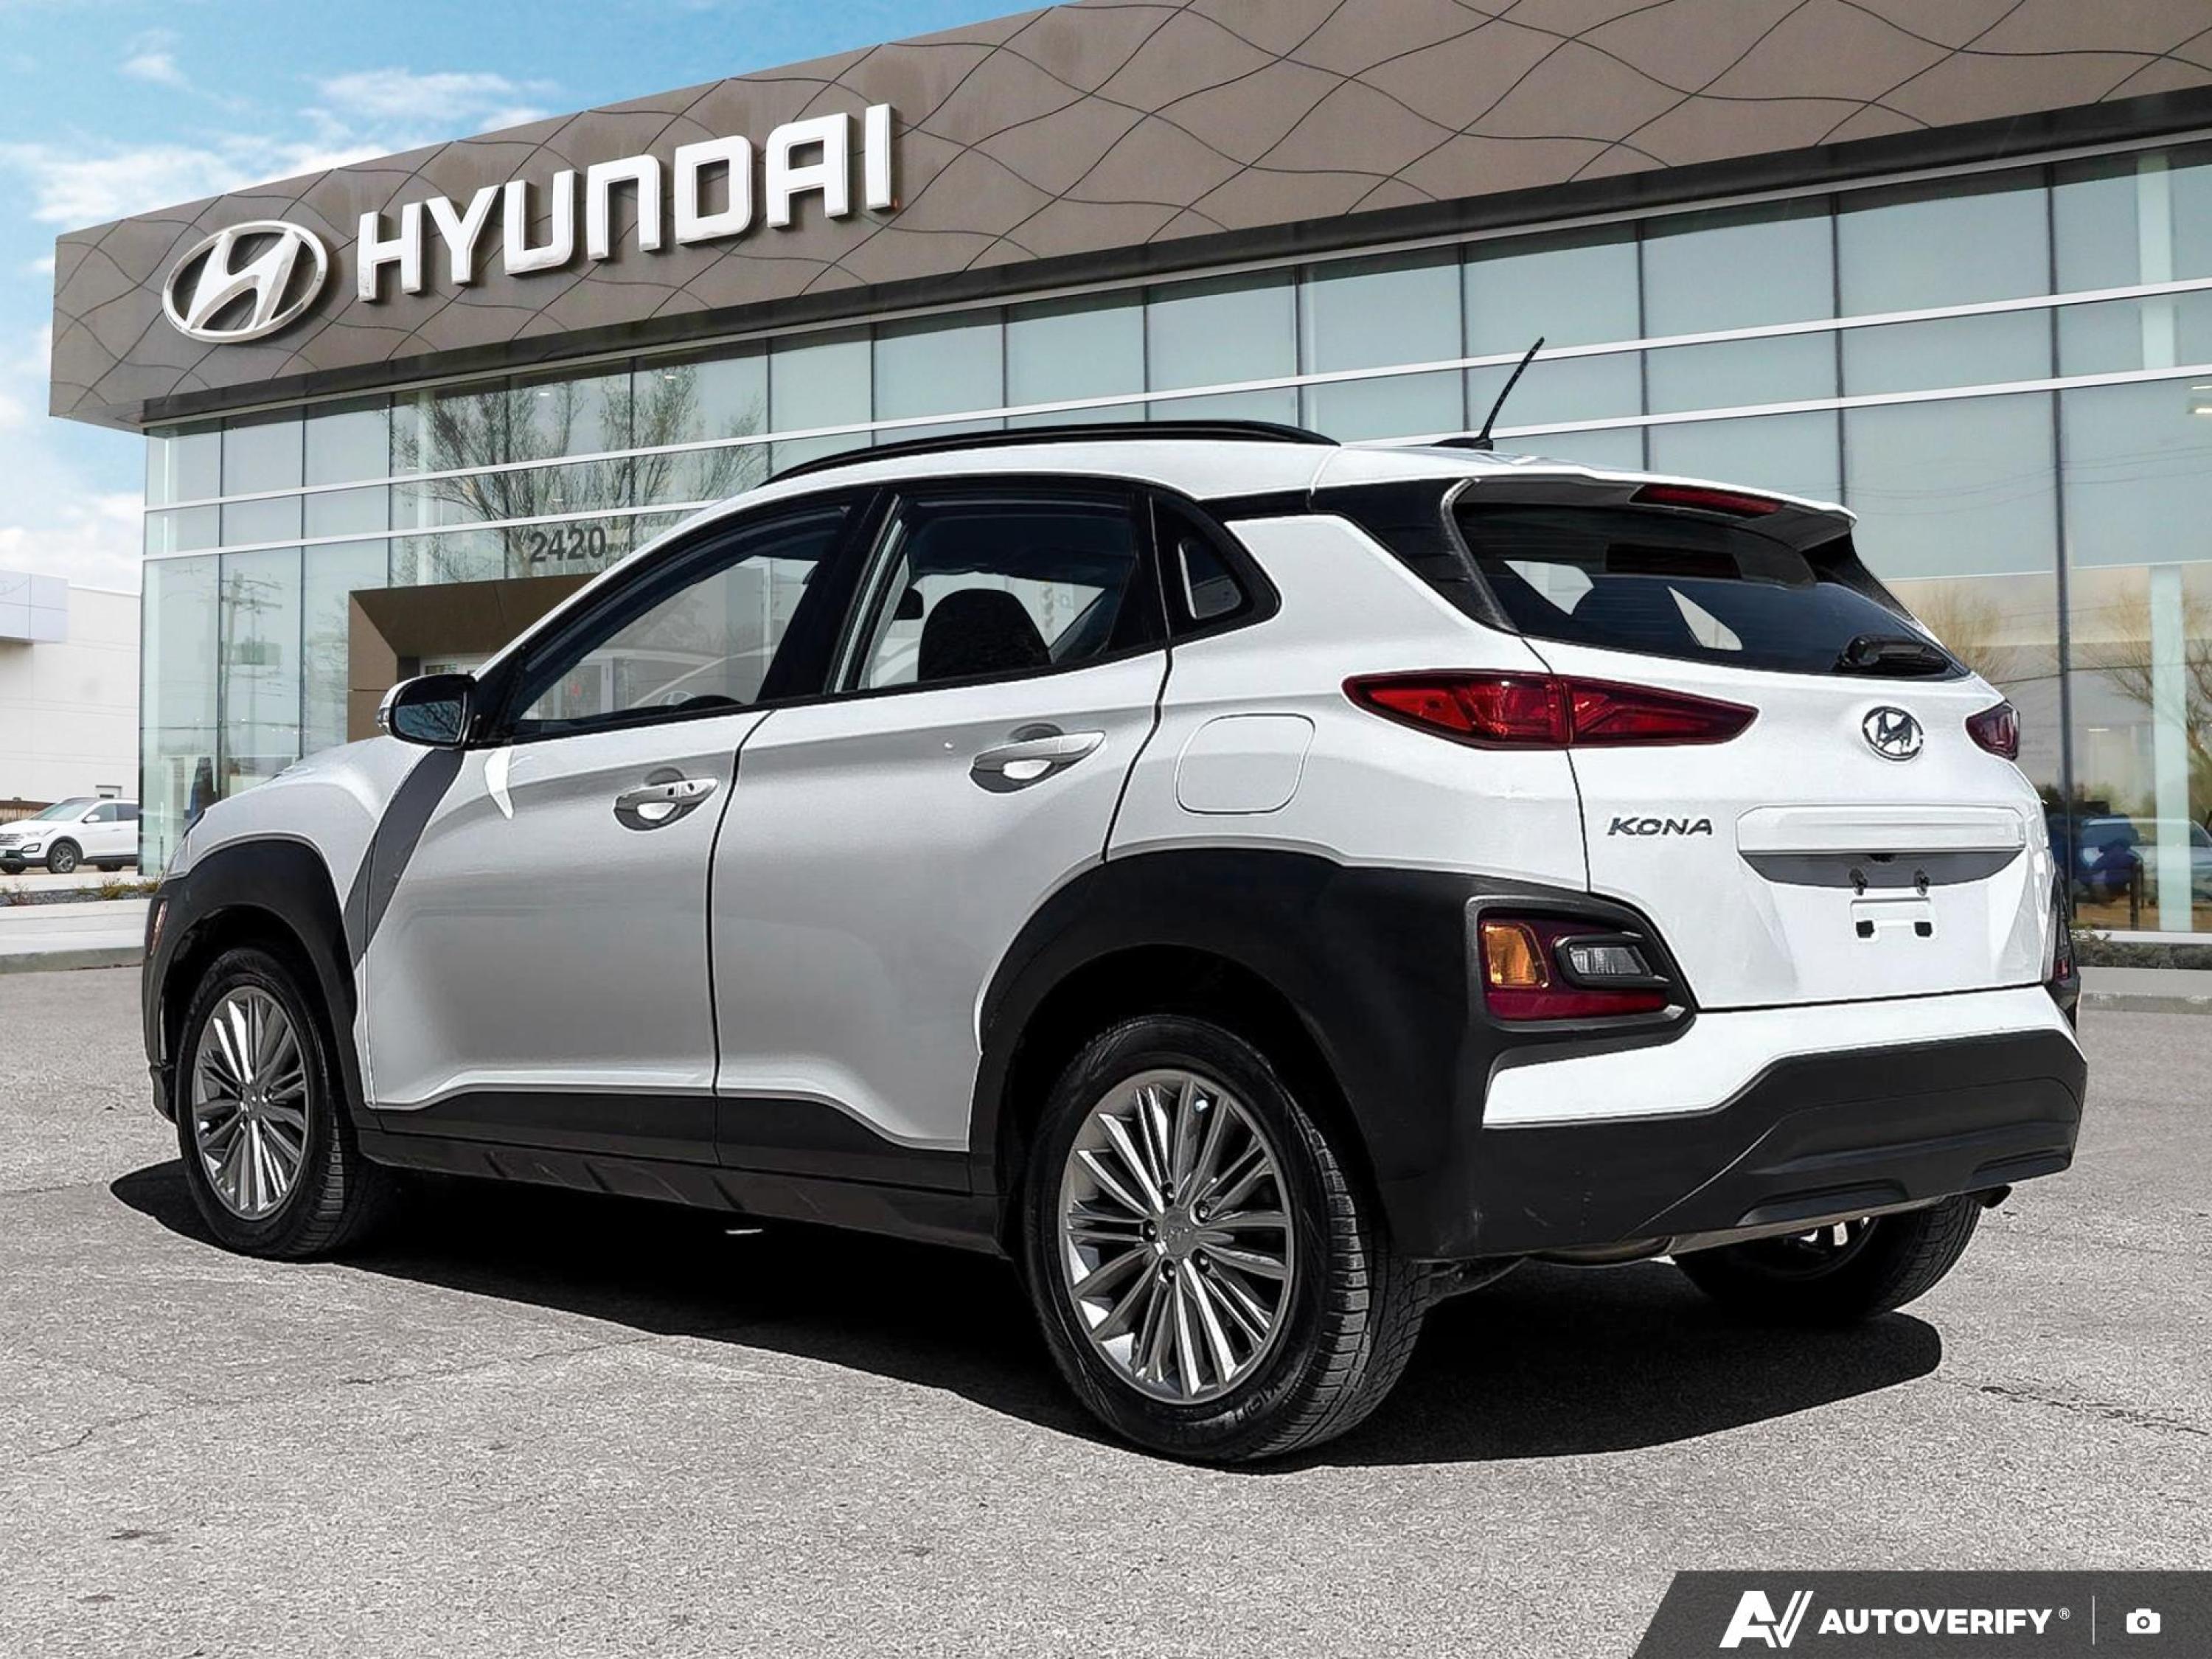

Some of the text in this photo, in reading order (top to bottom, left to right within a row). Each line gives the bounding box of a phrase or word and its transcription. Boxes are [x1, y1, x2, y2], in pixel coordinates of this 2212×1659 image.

[358, 102, 894, 302] HYUNDAI
[530, 526, 606, 563] 2420
[1607, 817, 1713, 836] KONA
